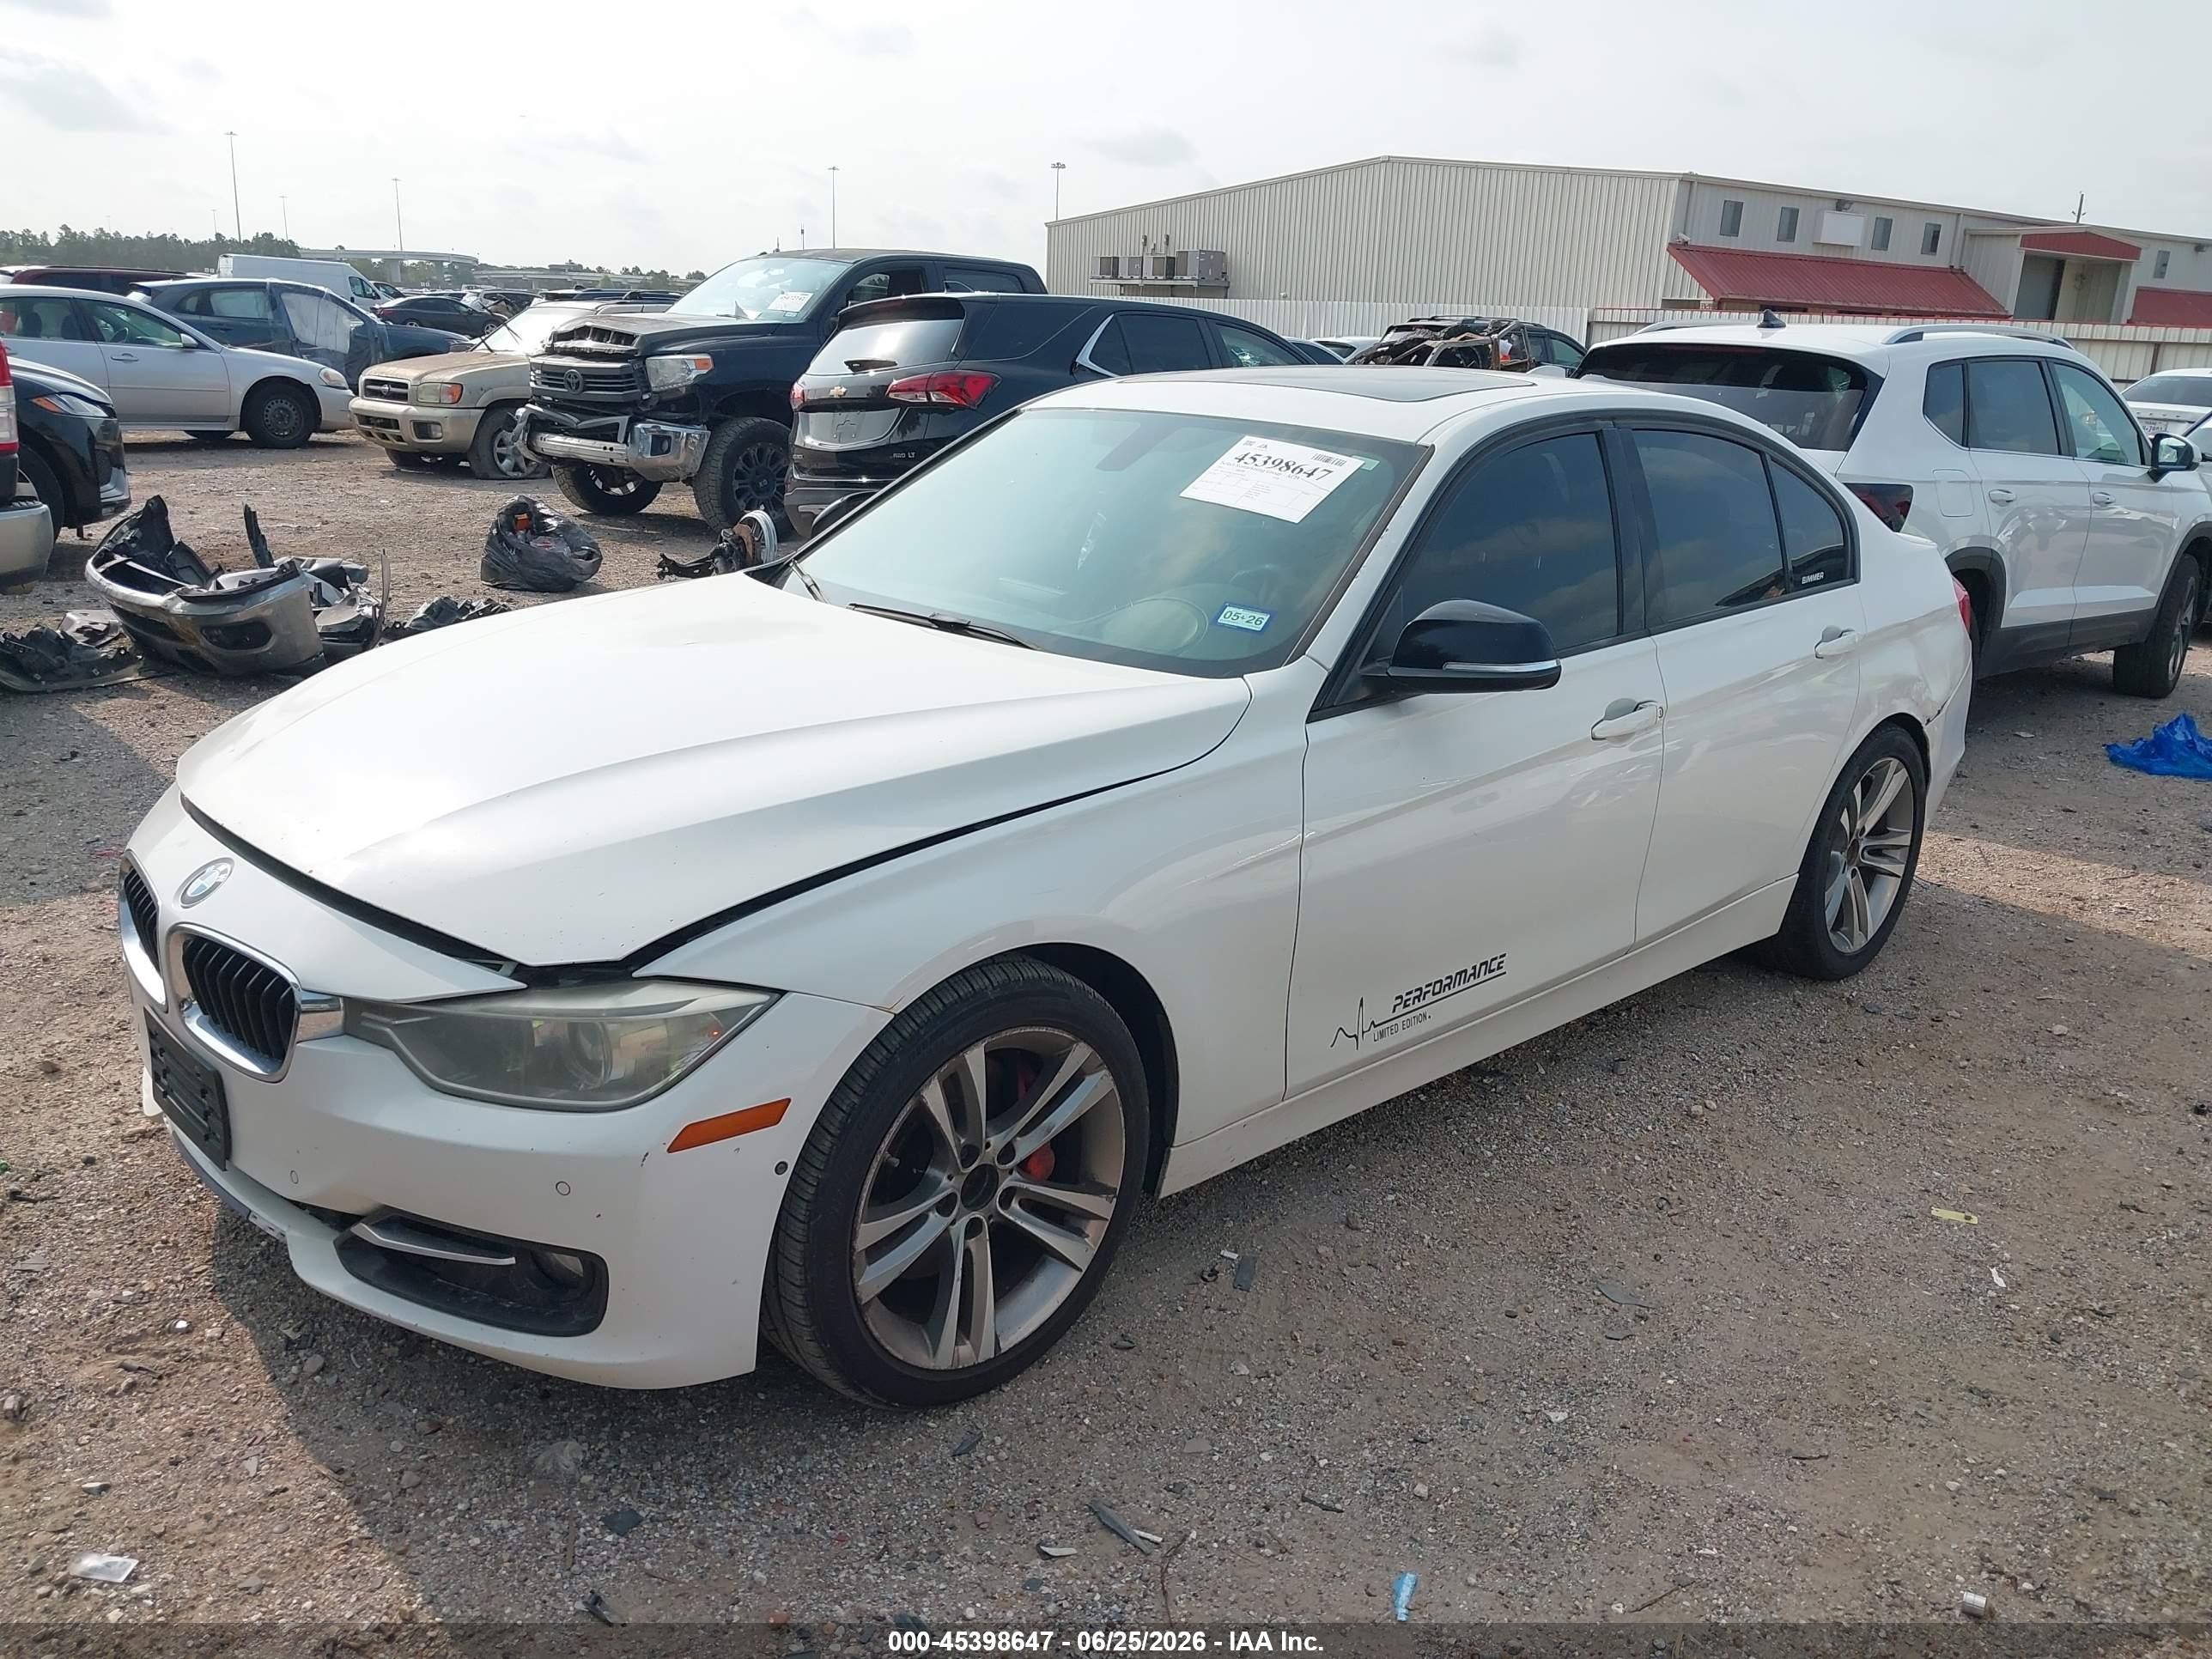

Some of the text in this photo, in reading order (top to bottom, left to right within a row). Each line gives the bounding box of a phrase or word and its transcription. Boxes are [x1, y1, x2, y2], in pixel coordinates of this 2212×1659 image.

[1234, 452, 1334, 482] 45398647
[1802, 571, 1825, 585] BIMMER
[1391, 952, 1507, 1013] PERFORMANCE
[1373, 1023, 1399, 1042] LIMITED
